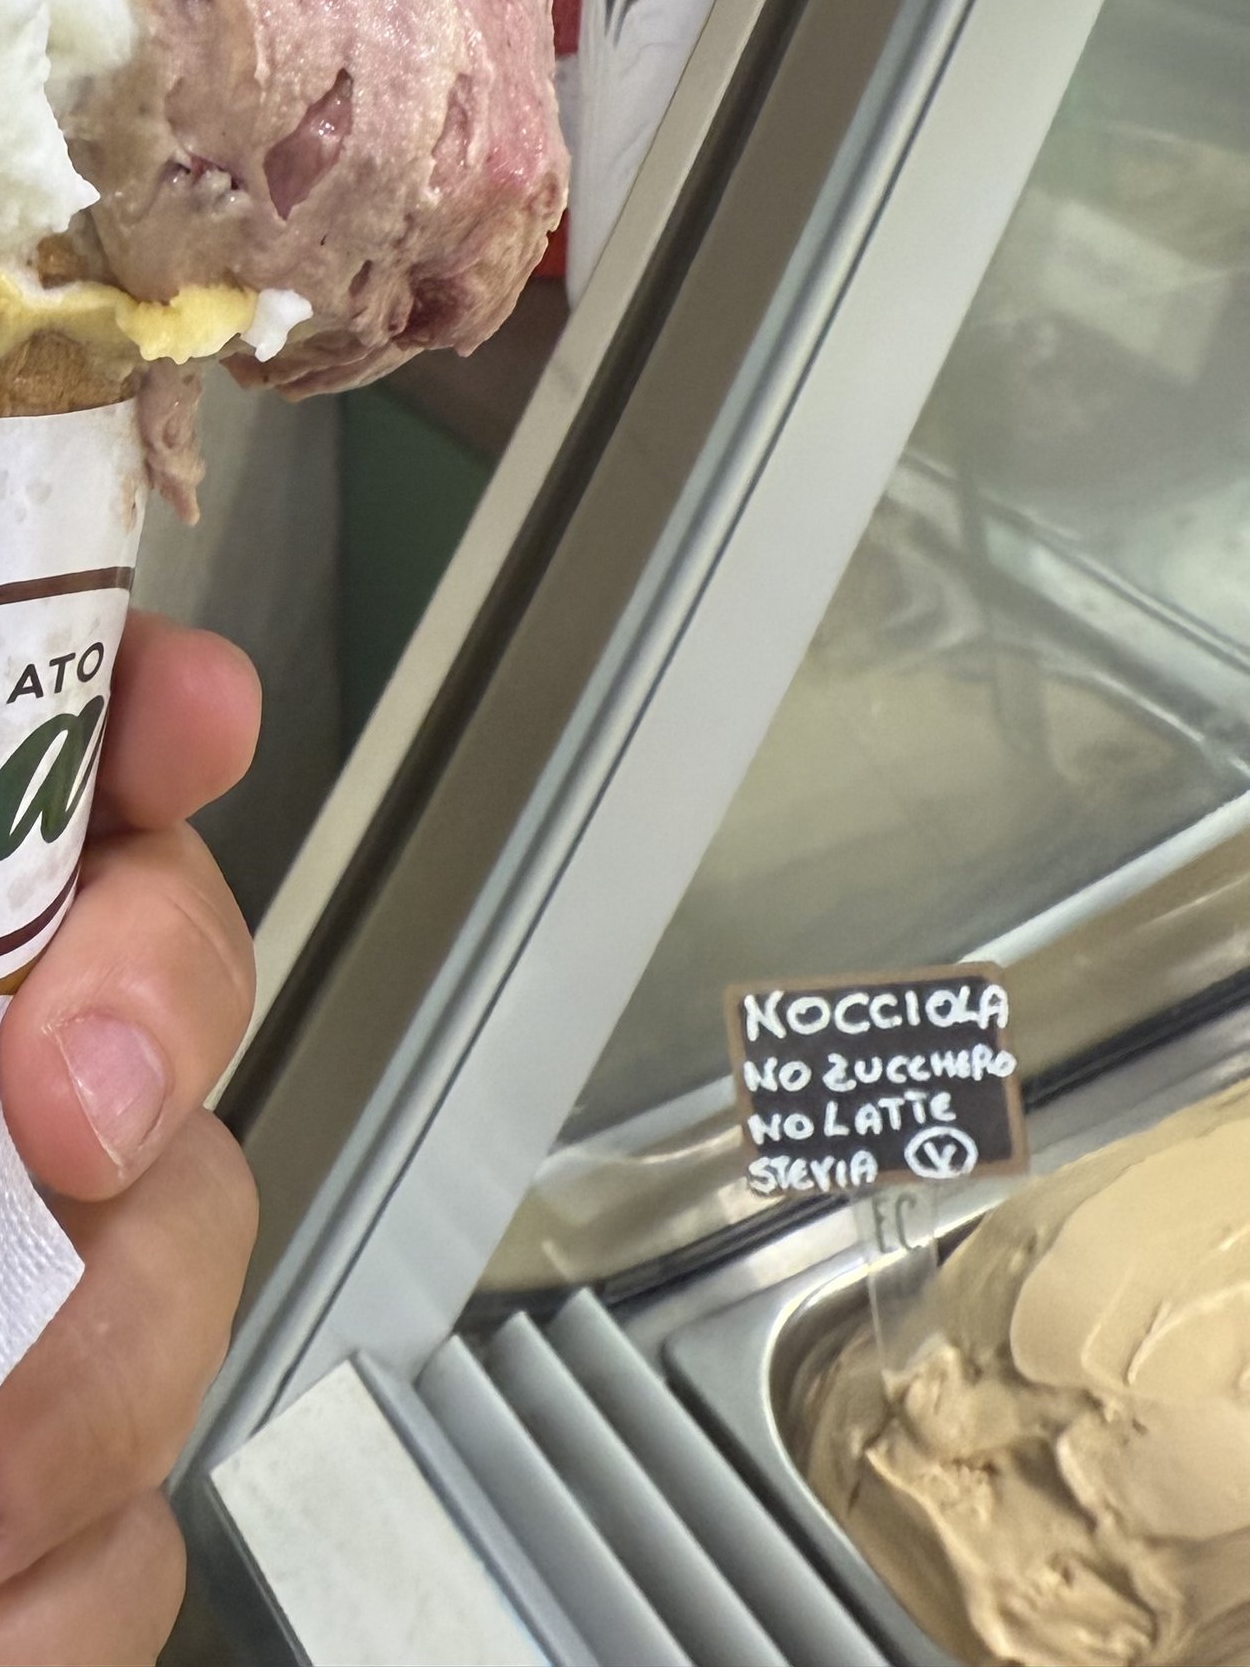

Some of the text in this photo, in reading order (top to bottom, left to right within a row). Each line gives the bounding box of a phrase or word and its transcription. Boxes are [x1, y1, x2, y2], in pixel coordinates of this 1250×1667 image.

[744, 984, 1009, 1042] NOCCIOLA
[743, 1042, 1017, 1092] NO ZUCCHERO
[747, 1089, 957, 1146] NO LATTE
[747, 1149, 879, 1194] STEVIA
